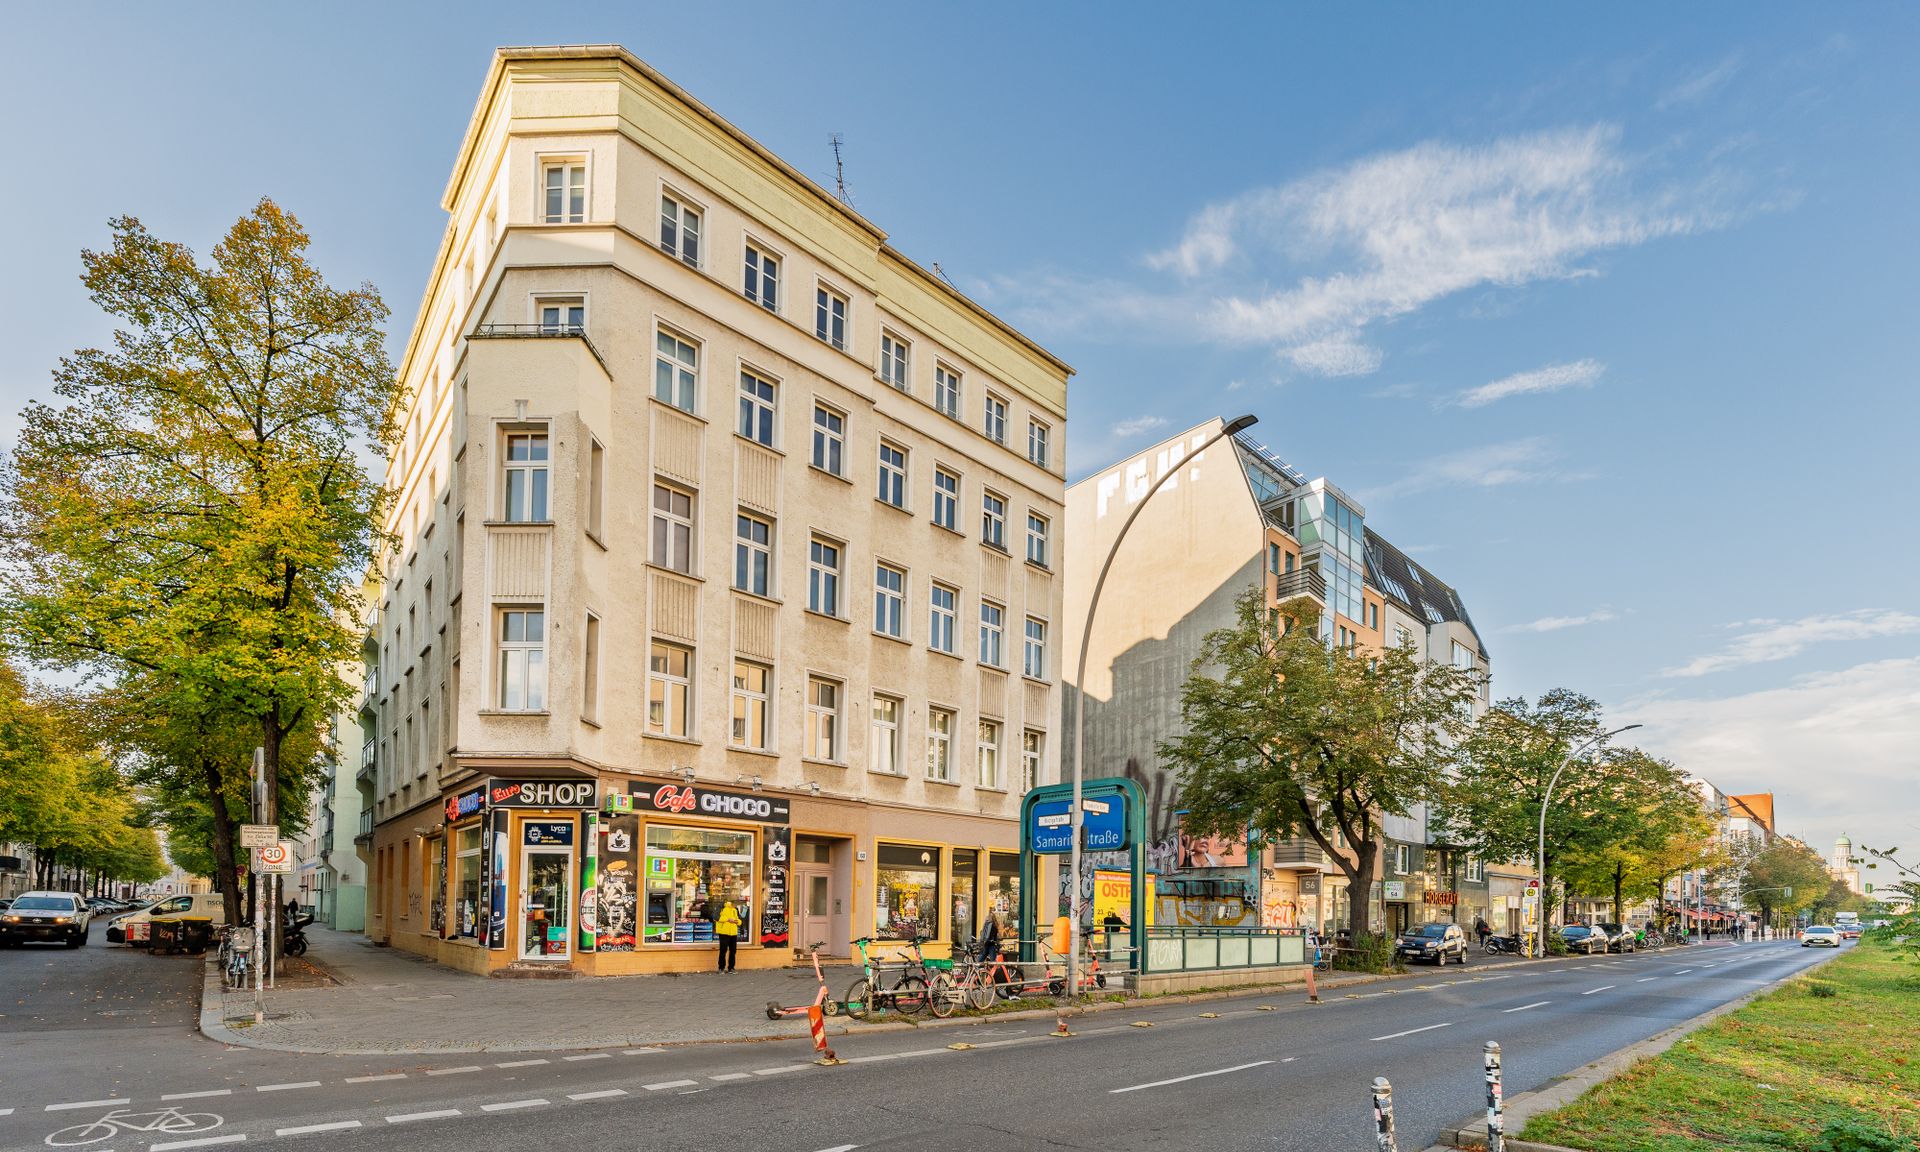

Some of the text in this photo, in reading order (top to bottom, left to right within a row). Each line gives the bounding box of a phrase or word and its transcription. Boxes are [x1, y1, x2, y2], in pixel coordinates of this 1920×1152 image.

[519, 783, 593, 805] SHOP
[654, 785, 770, 817] Café CHOCO
[266, 849, 281, 859] 30
[1305, 881, 1315, 889] 56
